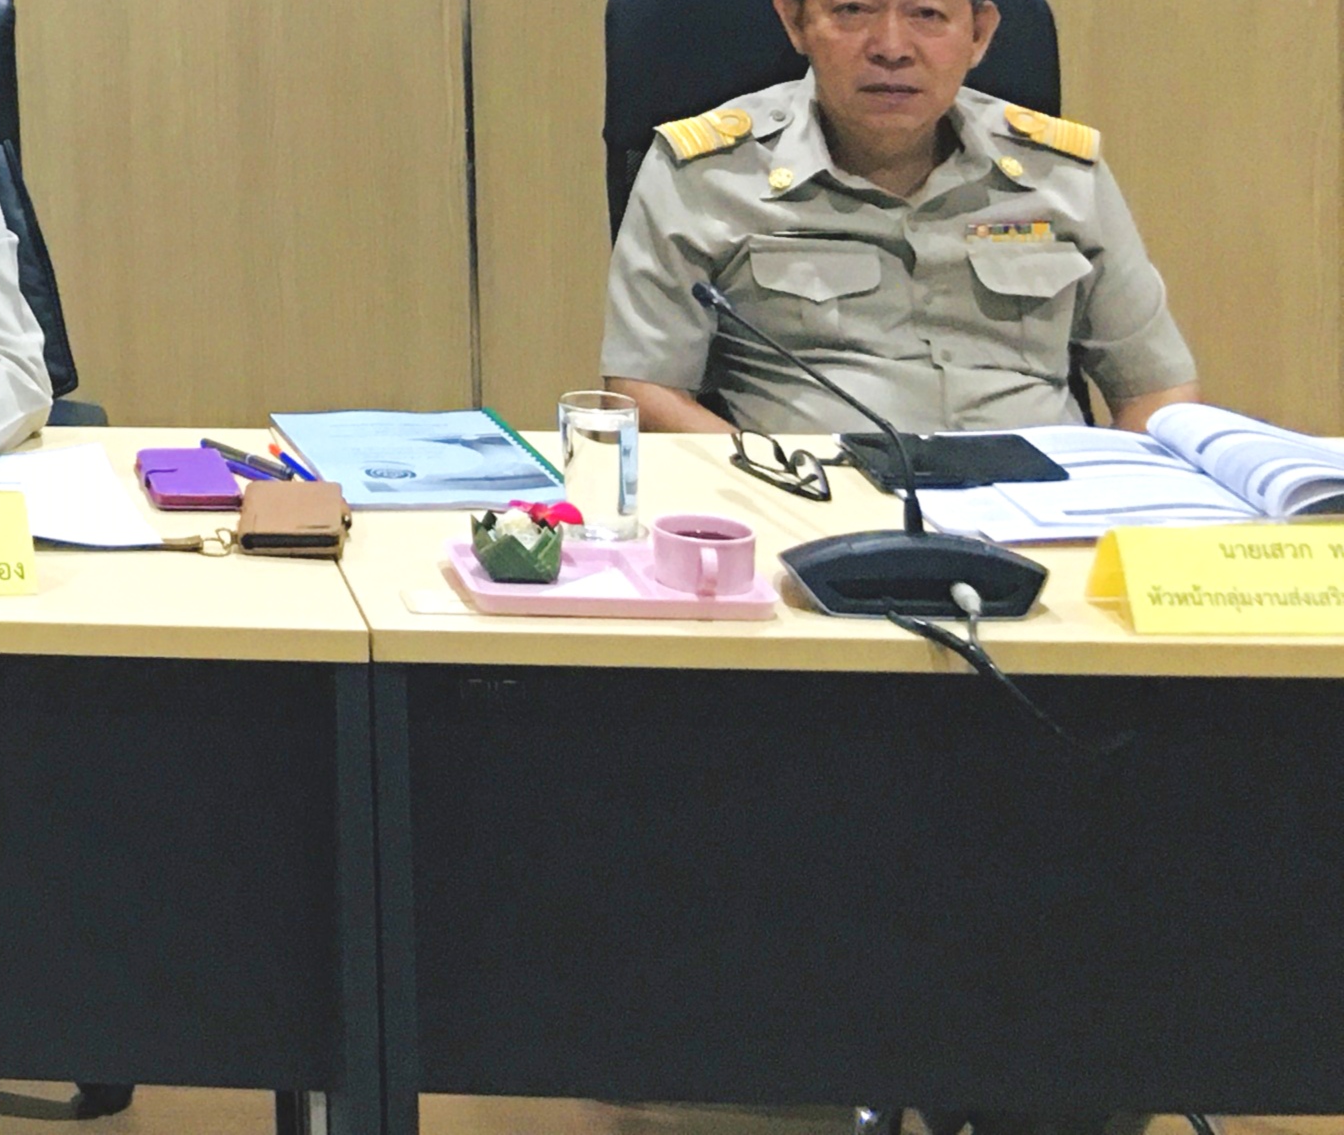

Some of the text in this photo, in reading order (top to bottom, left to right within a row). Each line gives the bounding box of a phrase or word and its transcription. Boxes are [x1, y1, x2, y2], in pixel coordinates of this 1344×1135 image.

[1218, 542, 1313, 559] นายเสวก
[1147, 584, 1344, 613] หัวหน้ากลุ่มงานส่งเสริ
